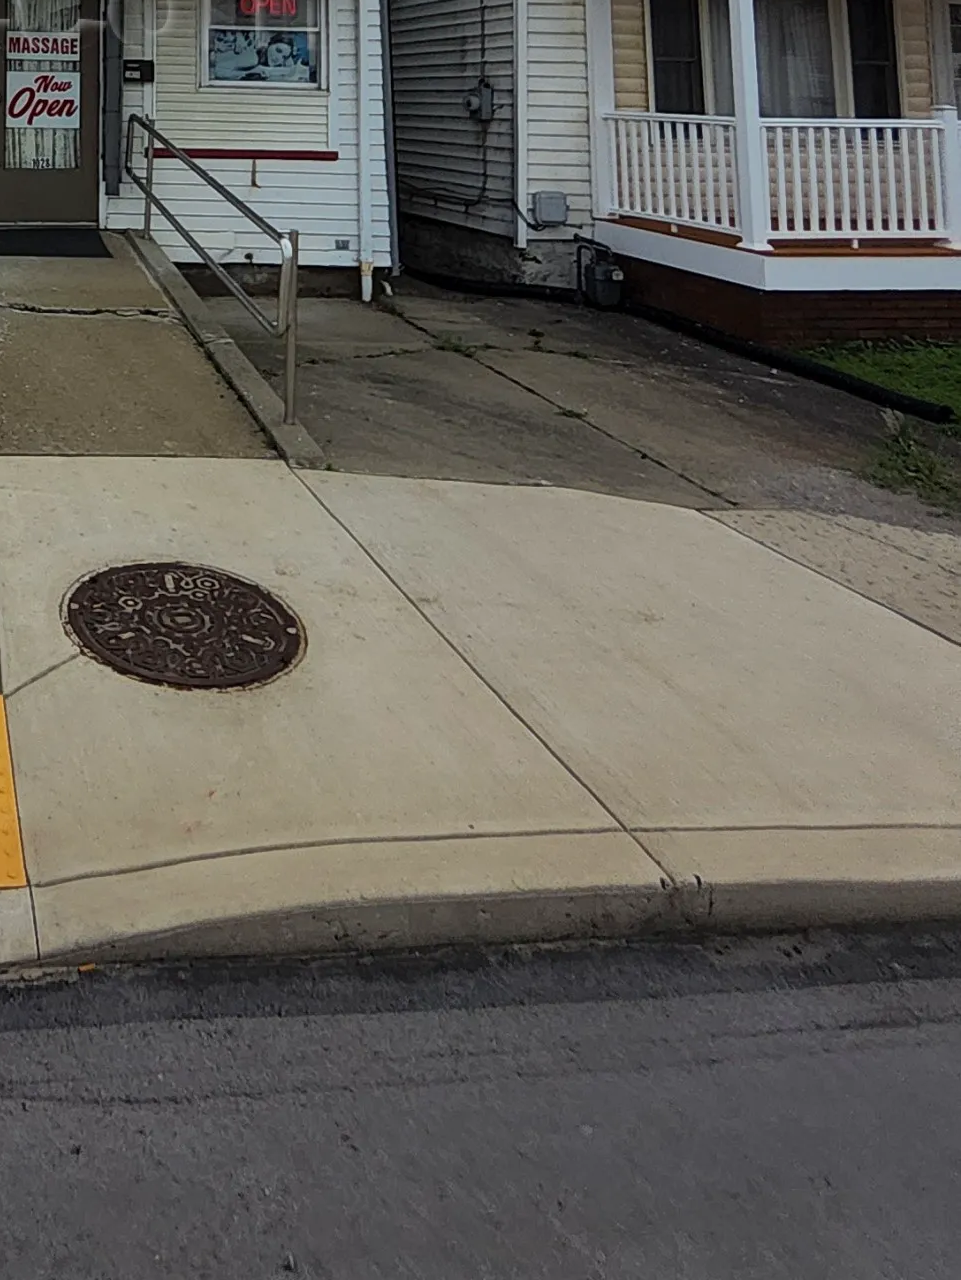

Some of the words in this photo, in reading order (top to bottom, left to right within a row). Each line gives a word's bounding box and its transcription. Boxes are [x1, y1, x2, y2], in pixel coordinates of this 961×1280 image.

[8, 36, 79, 55] MASSAGE
[34, 75, 73, 93] Now
[8, 86, 79, 126] Open
